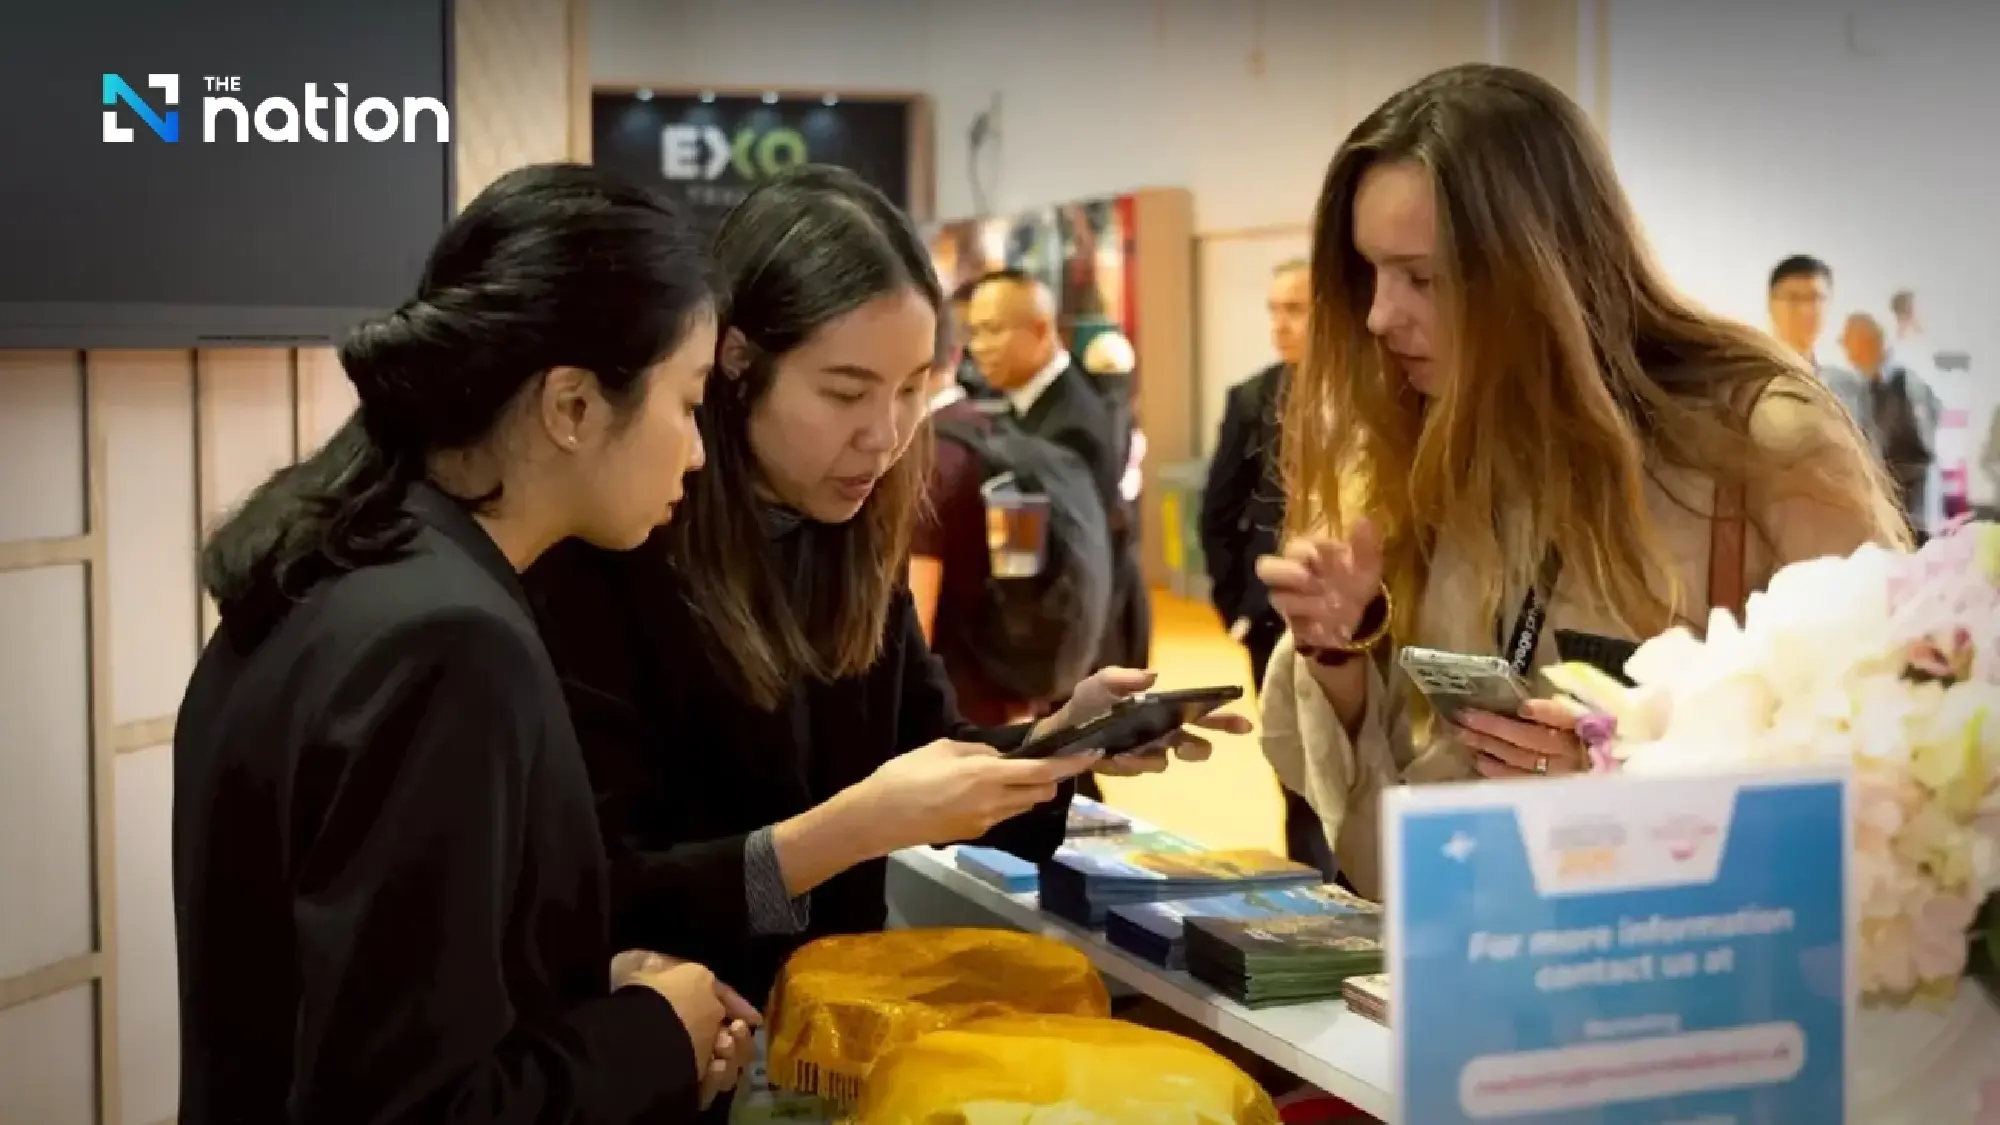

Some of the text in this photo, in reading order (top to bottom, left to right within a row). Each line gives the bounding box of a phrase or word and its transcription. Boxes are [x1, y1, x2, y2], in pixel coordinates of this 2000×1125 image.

[661, 125, 807, 181] EXO
[1468, 906, 1794, 963] For more information
[1534, 946, 1735, 992] contact us at
